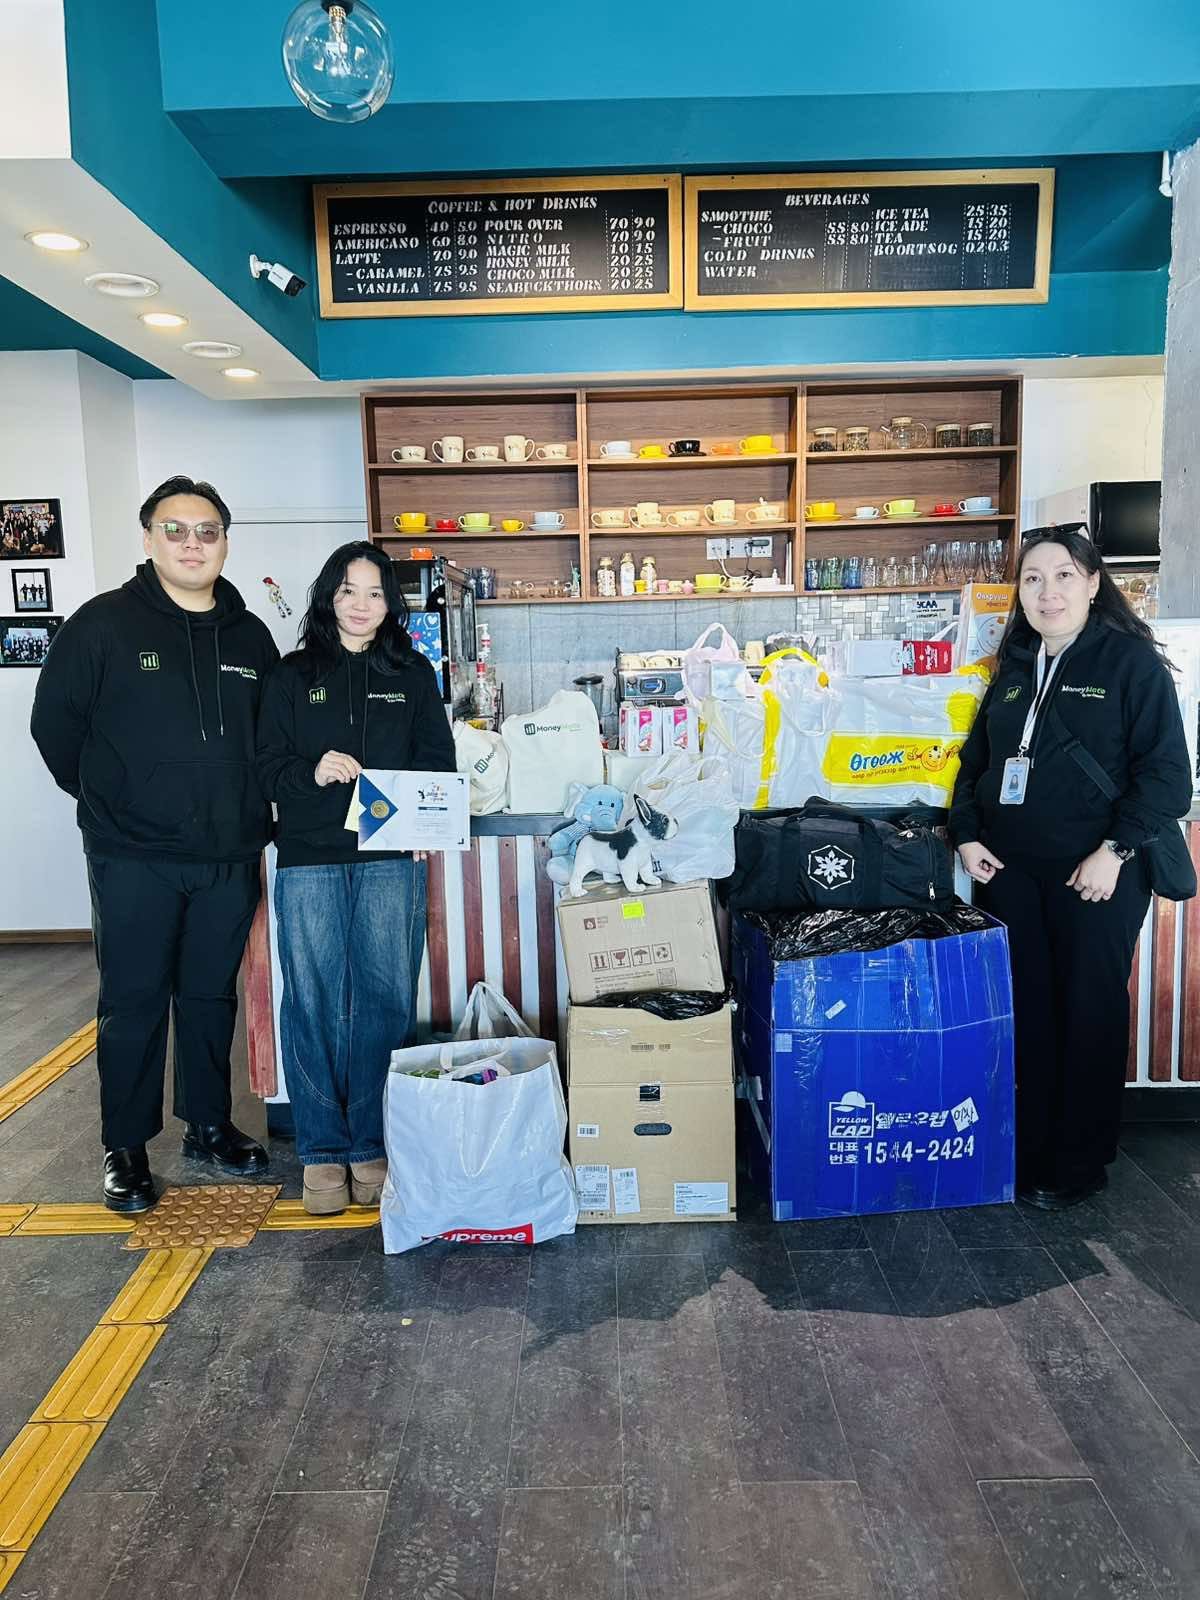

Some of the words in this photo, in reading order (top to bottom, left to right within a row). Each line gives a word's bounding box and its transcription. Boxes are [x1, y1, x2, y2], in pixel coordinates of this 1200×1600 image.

[428, 200, 482, 214] COFFEE
[505, 198, 535, 211] HOT
[543, 197, 598, 210] DRINKS
[785, 193, 870, 206] BEVERAGES
[701, 210, 773, 223] SMOOTHIE
[875, 208, 898, 220] ICE
[902, 207, 930, 219] TEA
[333, 222, 407, 236] ESPRESSO
[484, 219, 523, 232] POUR
[528, 219, 563, 231] OVER
[874, 221, 898, 232] ICE
[901, 220, 928, 232] ADE
[334, 237, 419, 251] AMERICANO
[874, 232, 903, 244] TEA
[486, 245, 531, 257] MAGIC
[535, 243, 571, 255] MILK
[704, 249, 748, 262] COLD
[759, 248, 815, 261] DRINKS
[874, 243, 958, 256] BOORTSOG
[335, 253, 381, 265] LATTE
[486, 256, 532, 269] HONEY
[535, 255, 571, 268] MILK
[487, 269, 535, 281] CHOCO
[539, 267, 575, 279] MILK
[705, 265, 757, 278] WATER
[836, 1116, 869, 1124] YELLOW
[831, 1125, 871, 1137] CAP
[829, 1141, 859, 1152] 대표
[829, 1154, 859, 1165] 번호
